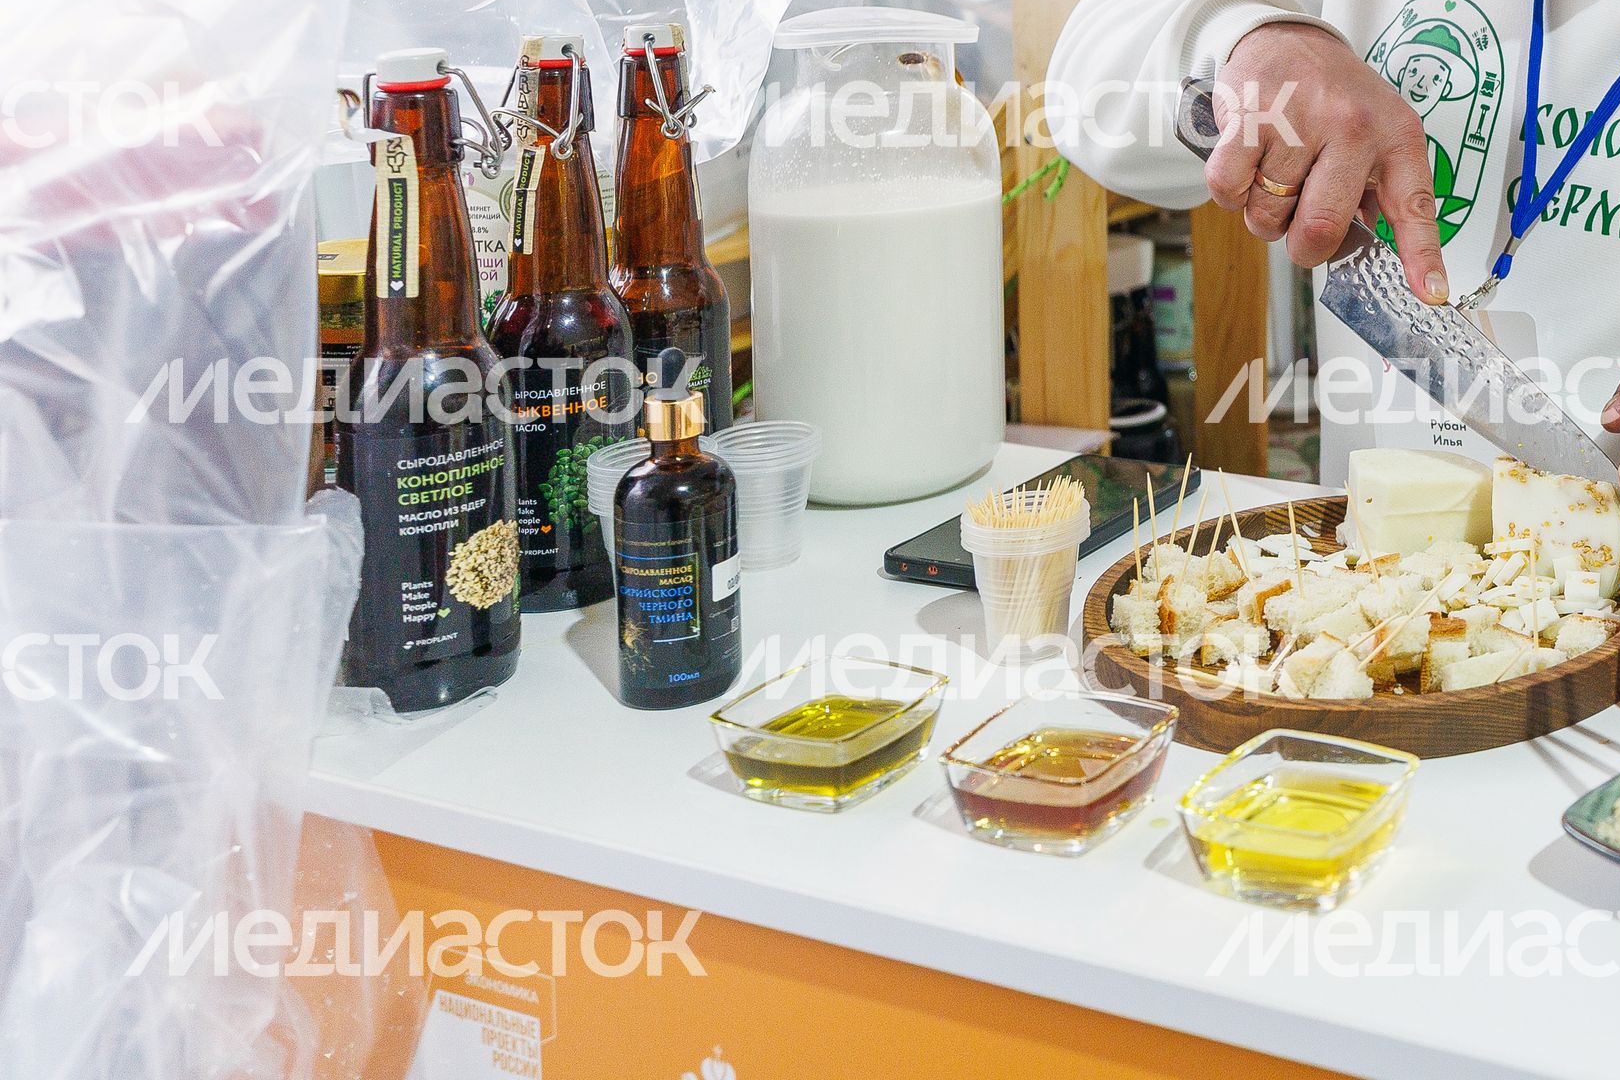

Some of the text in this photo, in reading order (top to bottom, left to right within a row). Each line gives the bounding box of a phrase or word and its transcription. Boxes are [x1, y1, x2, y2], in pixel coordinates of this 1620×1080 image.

[393, 182, 403, 229] PRODUCT
[514, 197, 525, 236] NATURAL
[391, 232, 403, 278] NATURAL
[514, 380, 607, 400] ЫРОДАВЛЕННОЕ
[514, 395, 607, 418] ЫКВЕННОЕ
[1430, 419, 1467, 432] Рубан
[1433, 434, 1463, 447] Илья
[397, 438, 504, 470] СЫРОДАВЛЕННОЕ
[396, 455, 505, 490] КОНОПЛЯНОЕ
[397, 482, 474, 506] СВЕТЛОЕ
[398, 498, 487, 523] МАСЛО ИЗ ЯДЕР
[399, 519, 460, 537] КОНОПЛИ
[518, 517, 541, 526] eople
[524, 547, 560, 556] PROPLANT
[401, 581, 434, 591] Plants
[658, 574, 694, 586] МАСЛО
[401, 592, 430, 601] Make
[619, 585, 694, 599] СИРИЙСКОГО
[402, 601, 438, 612] People
[639, 598, 694, 612] ЧЕРНОГО
[402, 612, 437, 623] Happy
[648, 611, 695, 625] ТМИНА
[416, 632, 459, 647] PROPLANT
[481, 1027, 538, 1060] ПРОЕКТЫ
